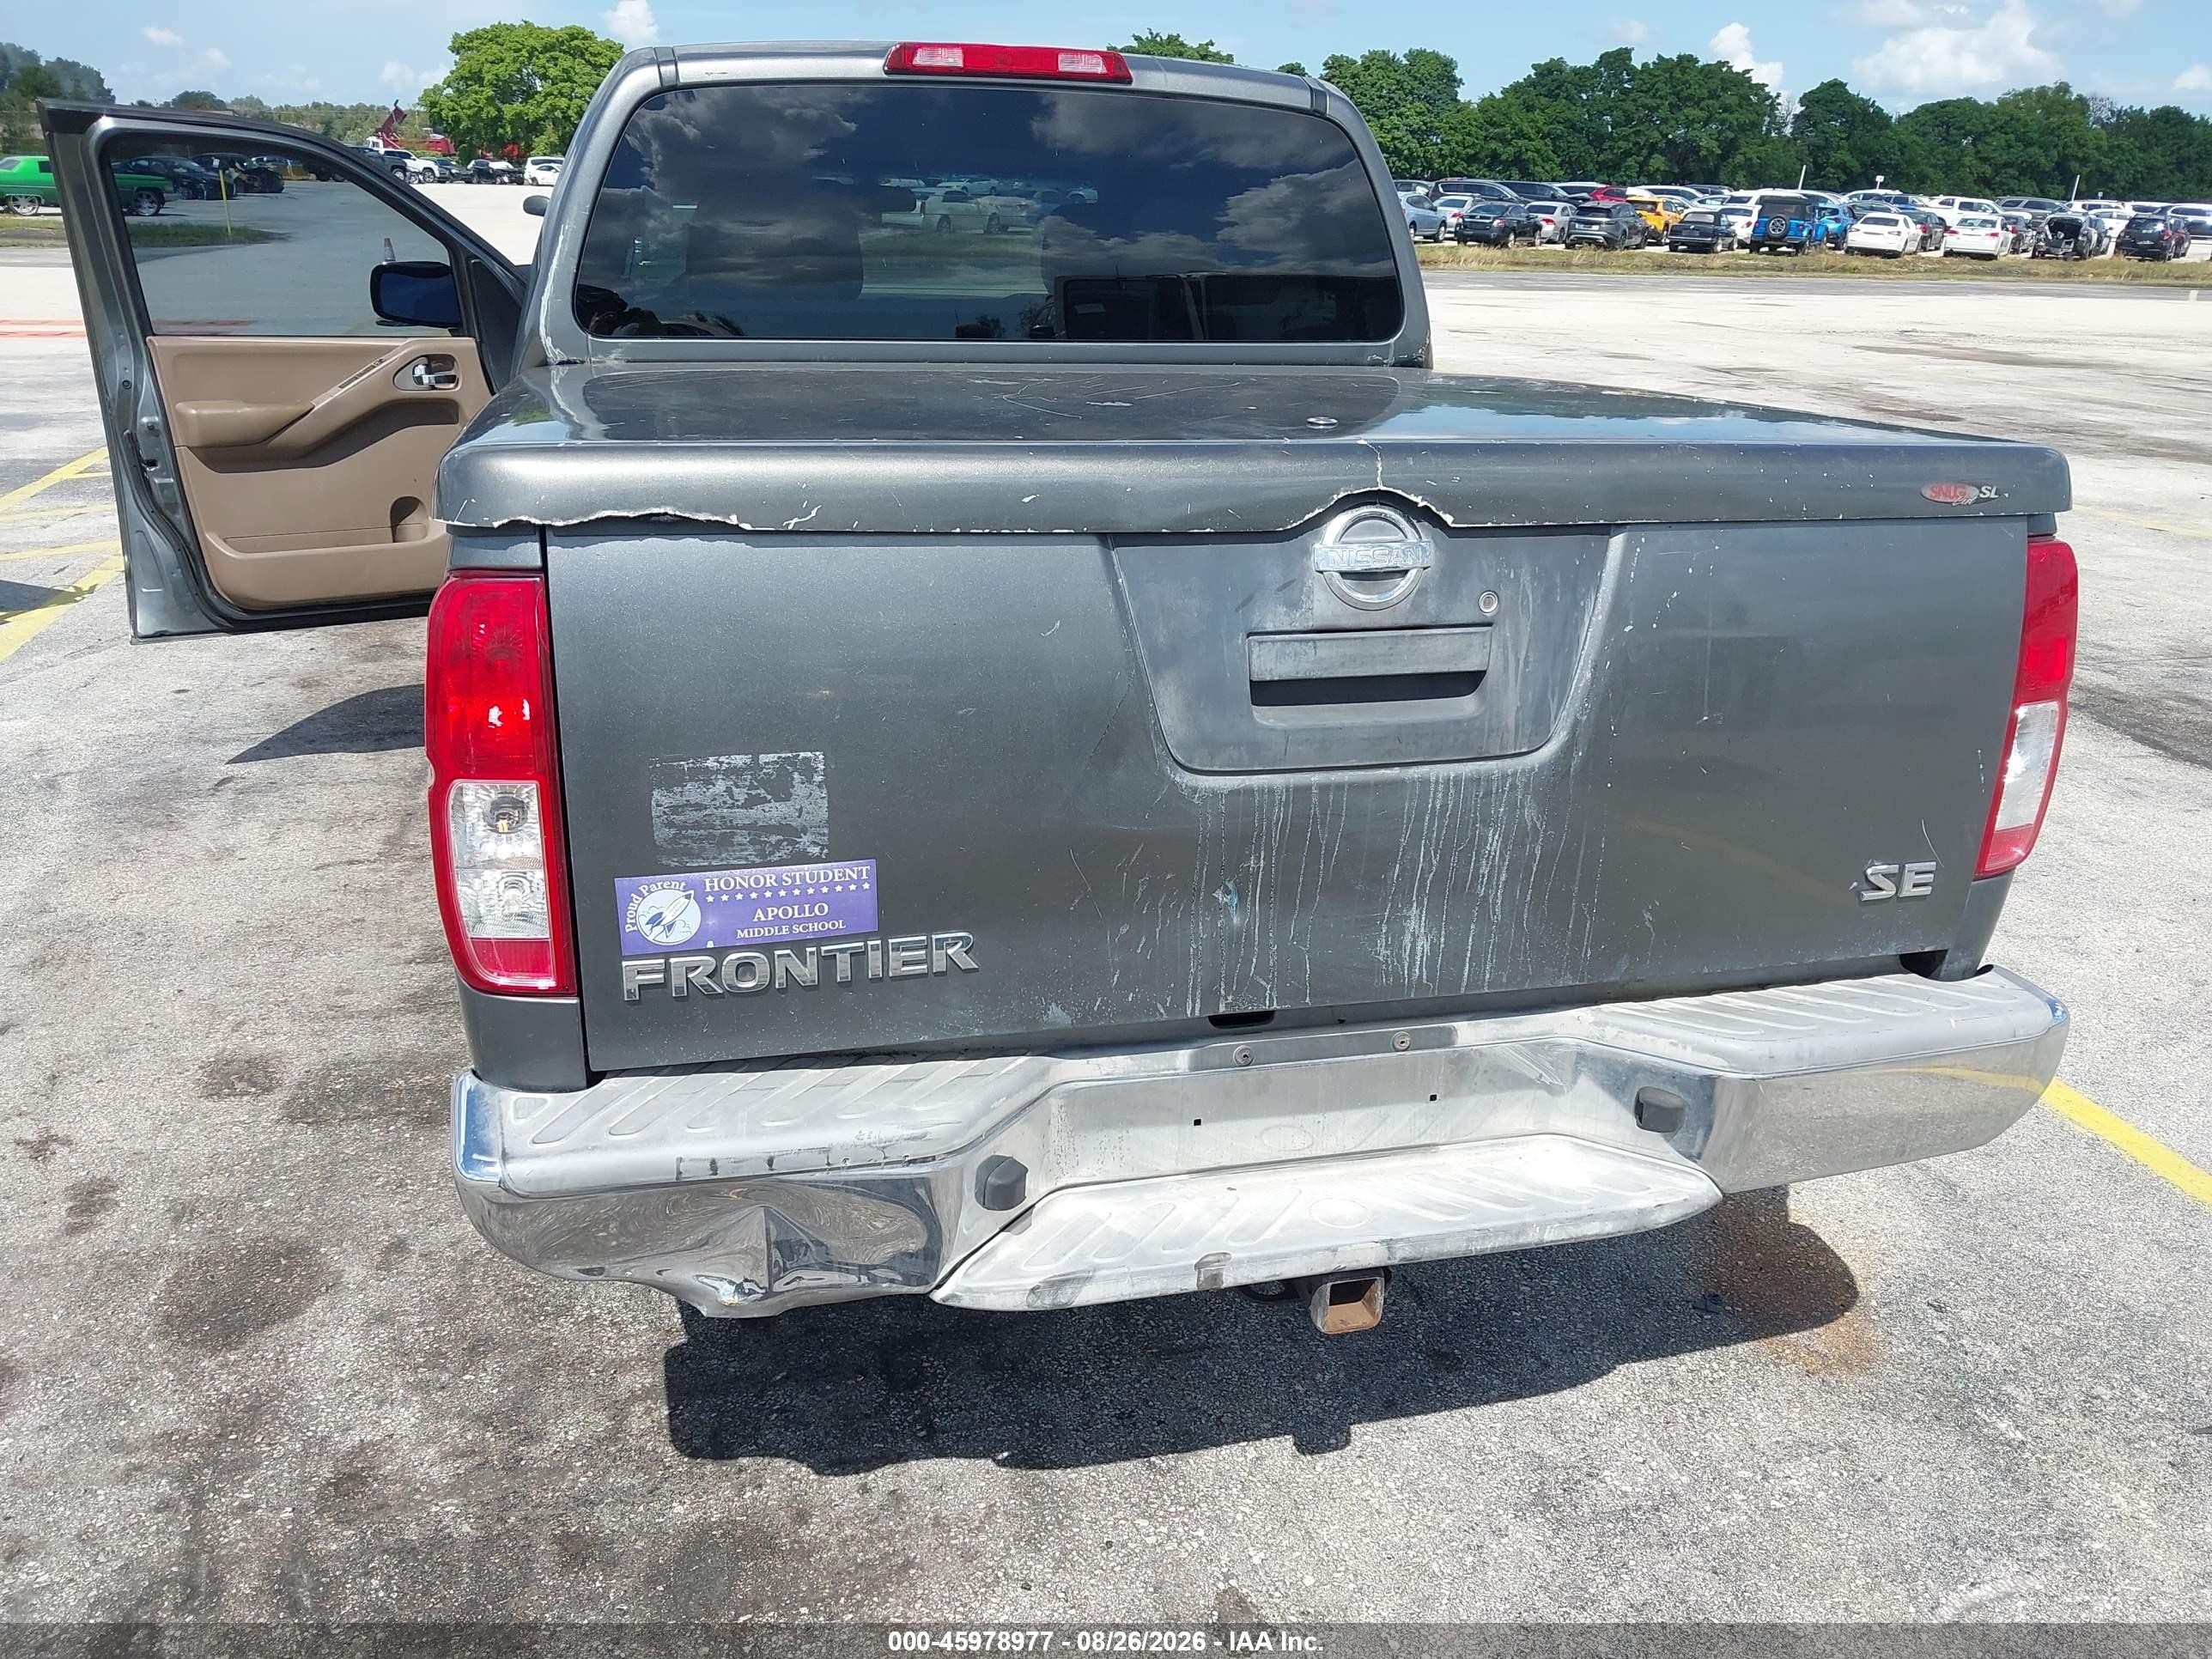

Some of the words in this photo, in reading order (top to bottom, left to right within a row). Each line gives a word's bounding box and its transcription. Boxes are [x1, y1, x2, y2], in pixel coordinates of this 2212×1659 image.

[1979, 485, 2000, 498] SL
[1329, 545, 1423, 568] NISSAN
[704, 874, 778, 892] HONOR
[781, 866, 871, 886] STUDENT
[1861, 861, 1937, 902] SE
[625, 893, 643, 933] Proud
[638, 880, 687, 896] Parent
[752, 902, 829, 922] APOLLO
[736, 924, 790, 939] MIDDLE
[792, 920, 847, 934] SCHOOL
[621, 932, 980, 1001] FRONTIER
